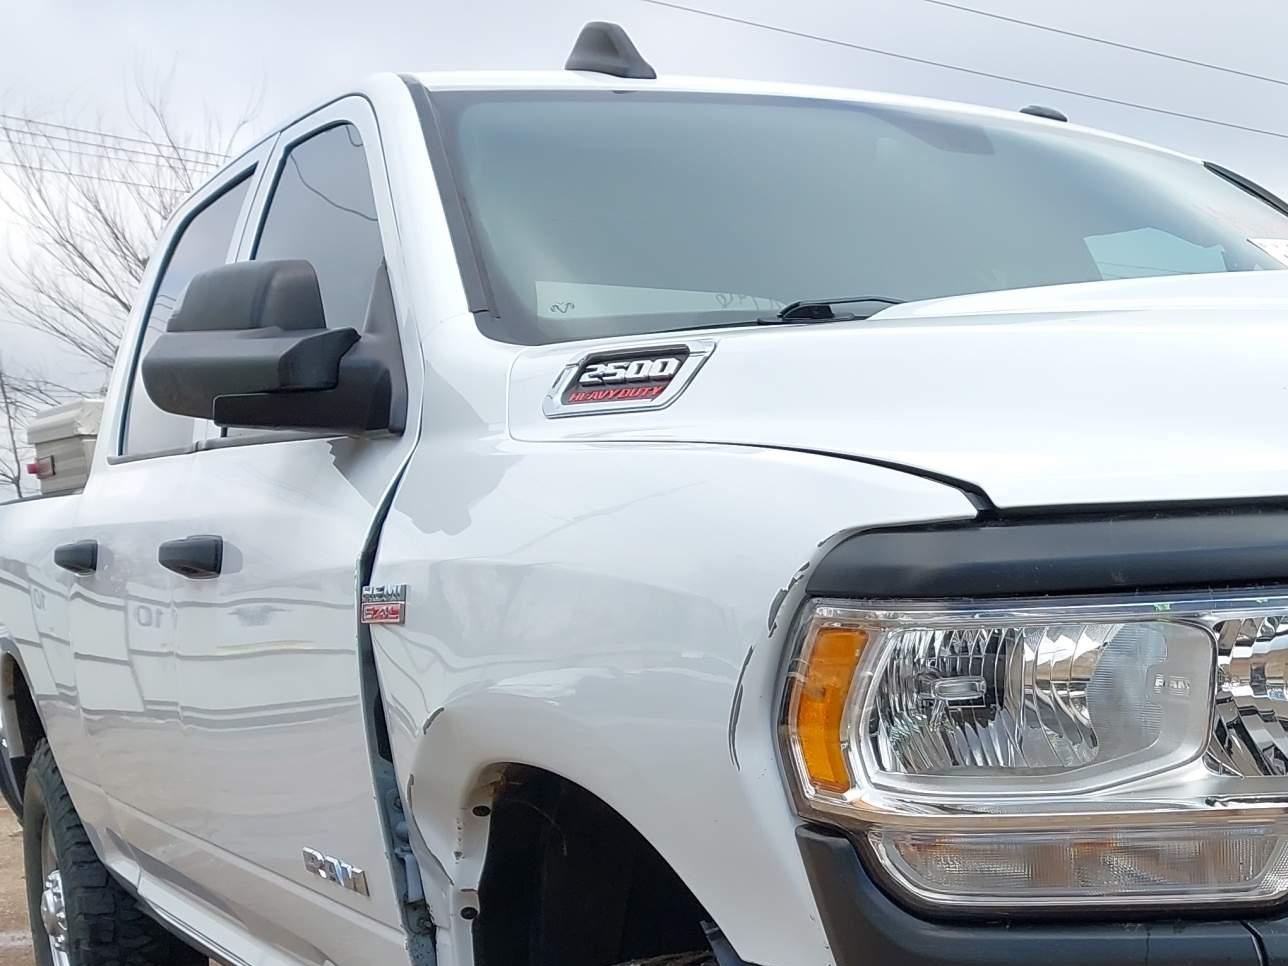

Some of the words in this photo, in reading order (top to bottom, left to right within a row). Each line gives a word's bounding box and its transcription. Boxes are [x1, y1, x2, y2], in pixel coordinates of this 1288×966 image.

[578, 357, 682, 386] 2500
[568, 388, 618, 402] HEAVY
[617, 386, 663, 399] DUTY
